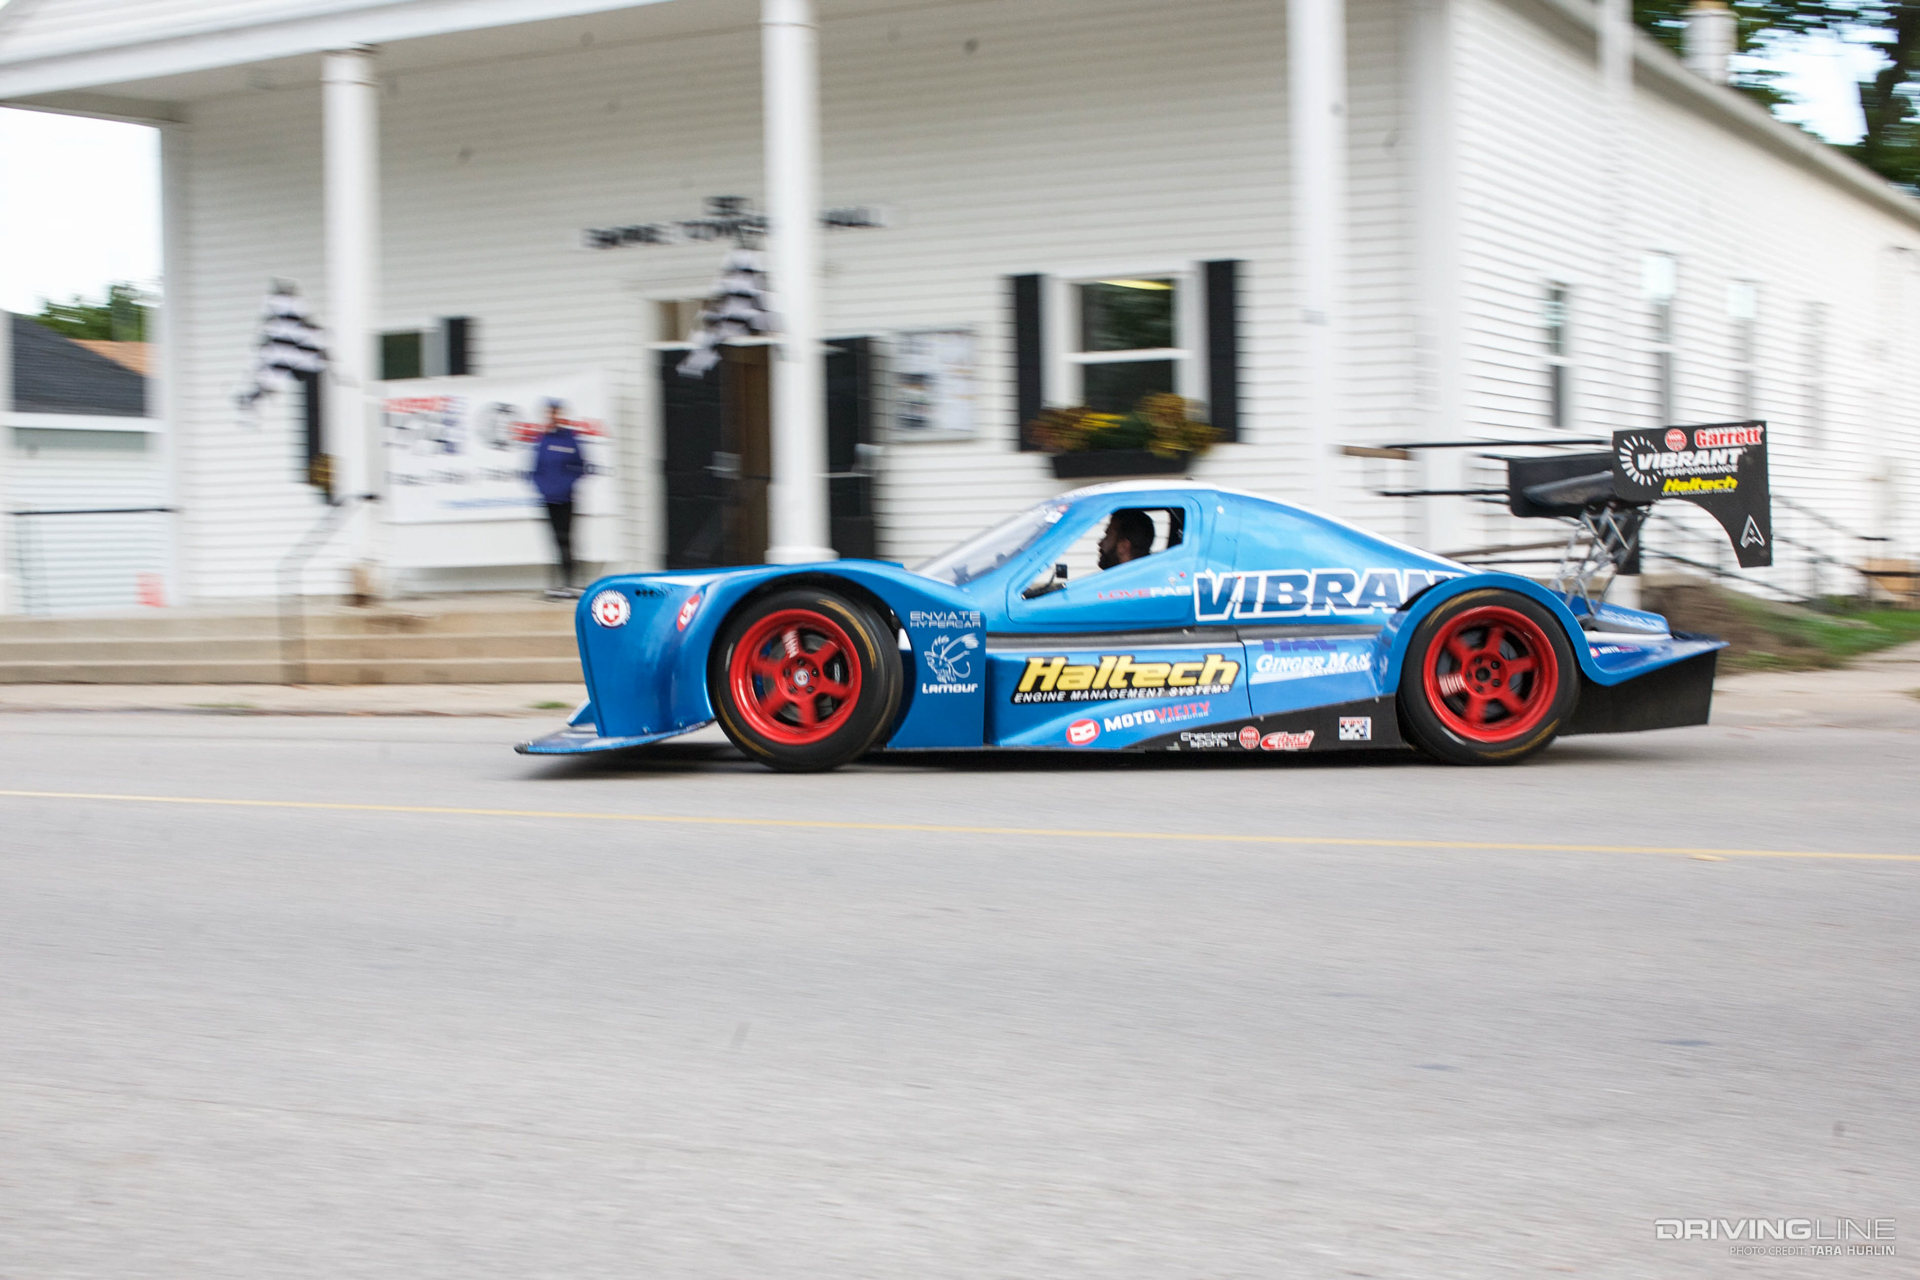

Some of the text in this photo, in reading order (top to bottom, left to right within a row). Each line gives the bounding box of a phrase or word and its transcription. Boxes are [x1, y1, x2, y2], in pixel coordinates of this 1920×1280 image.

[1695, 425, 1764, 448] Garrett
[1636, 448, 1744, 470] VIBRANT
[1662, 475, 1738, 492] Haltech
[1193, 568, 1466, 621] VIBRAN
[910, 610, 980, 620] ENVIATE
[910, 620, 981, 628] HYPERCAR
[1018, 654, 1239, 692] Haltech
[1014, 684, 1230, 703] ENGINE MANAGEMENT SYSTEMS
[1104, 701, 1210, 732] MOTOVICITY
